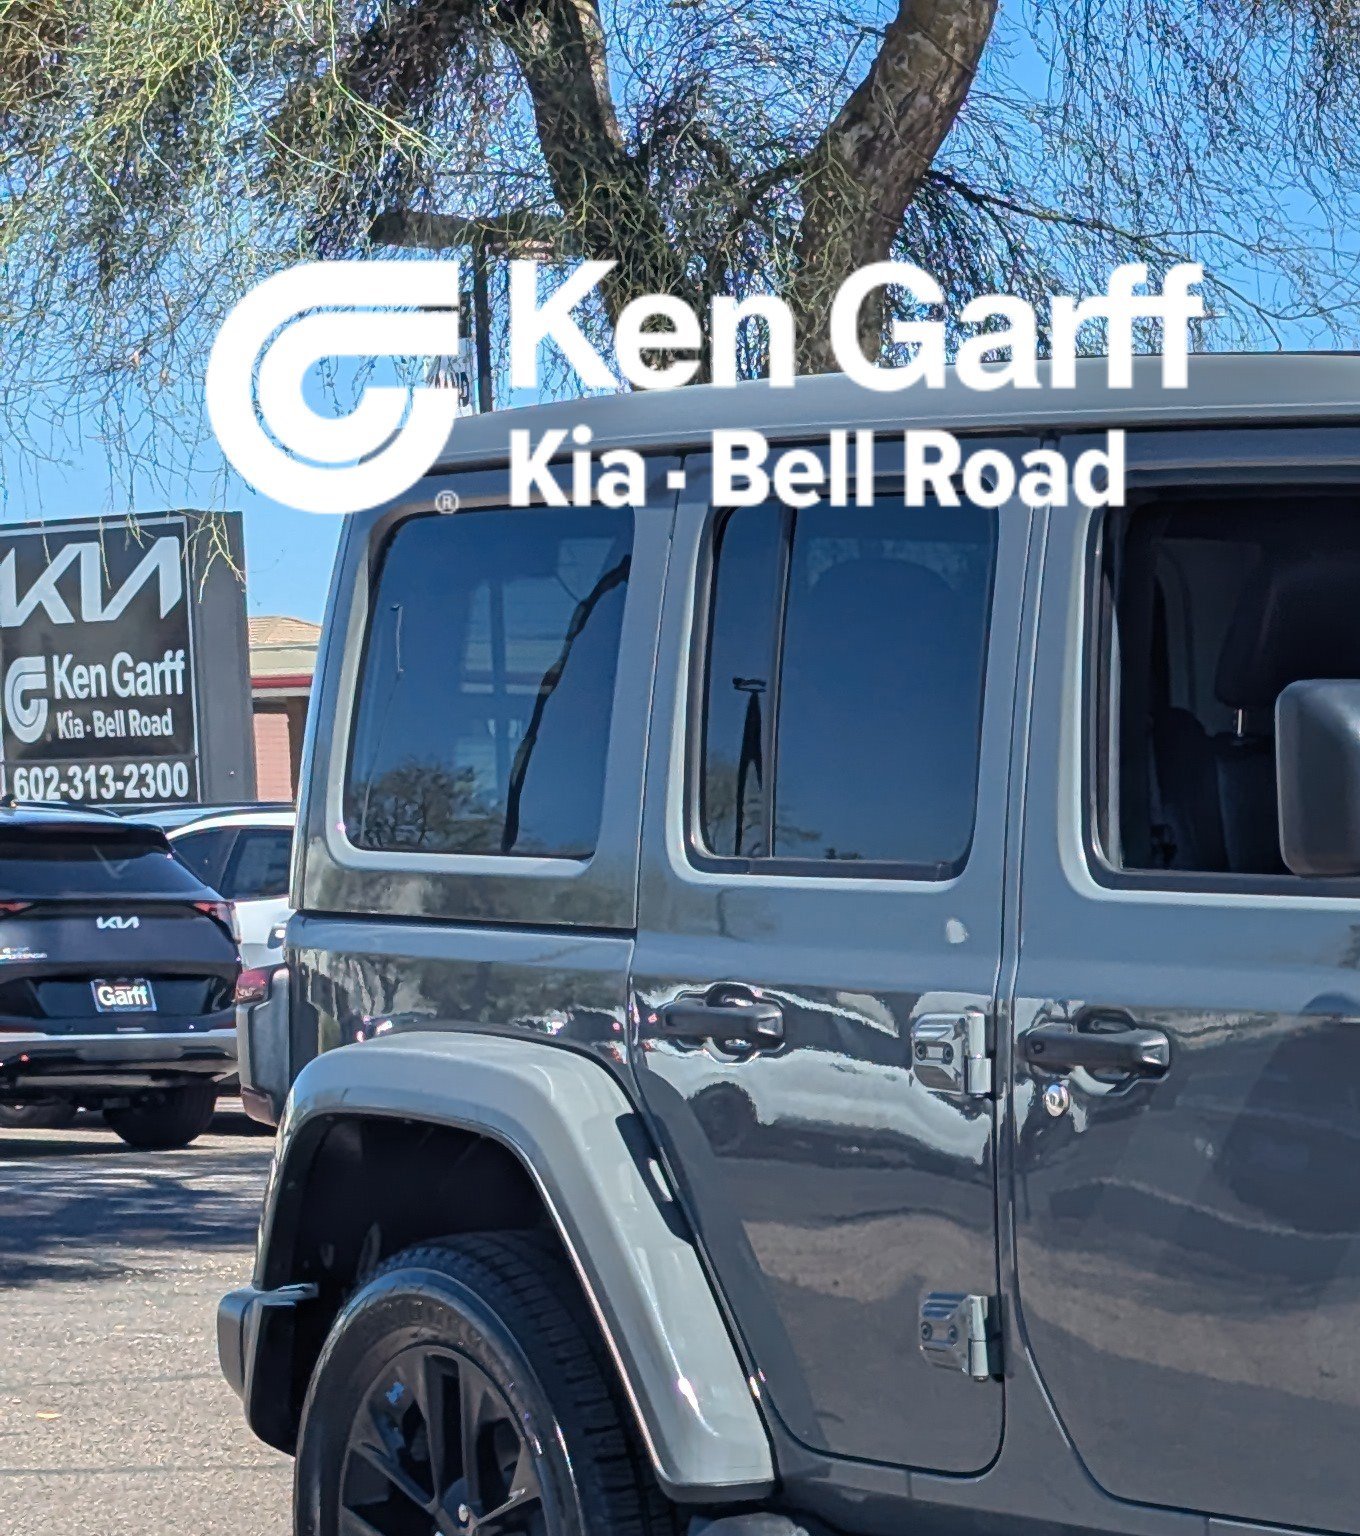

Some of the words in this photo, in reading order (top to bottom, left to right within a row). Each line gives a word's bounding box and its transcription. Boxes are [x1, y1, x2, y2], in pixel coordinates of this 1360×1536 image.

[0, 535, 182, 628] KIA
[52, 653, 107, 700] Ken
[112, 649, 185, 697] Garff
[56, 709, 84, 739] Kia
[92, 709, 126, 738] Bell
[128, 708, 174, 736] Road
[14, 761, 188, 801] 602-313-2300
[97, 985, 148, 1006] Garff
